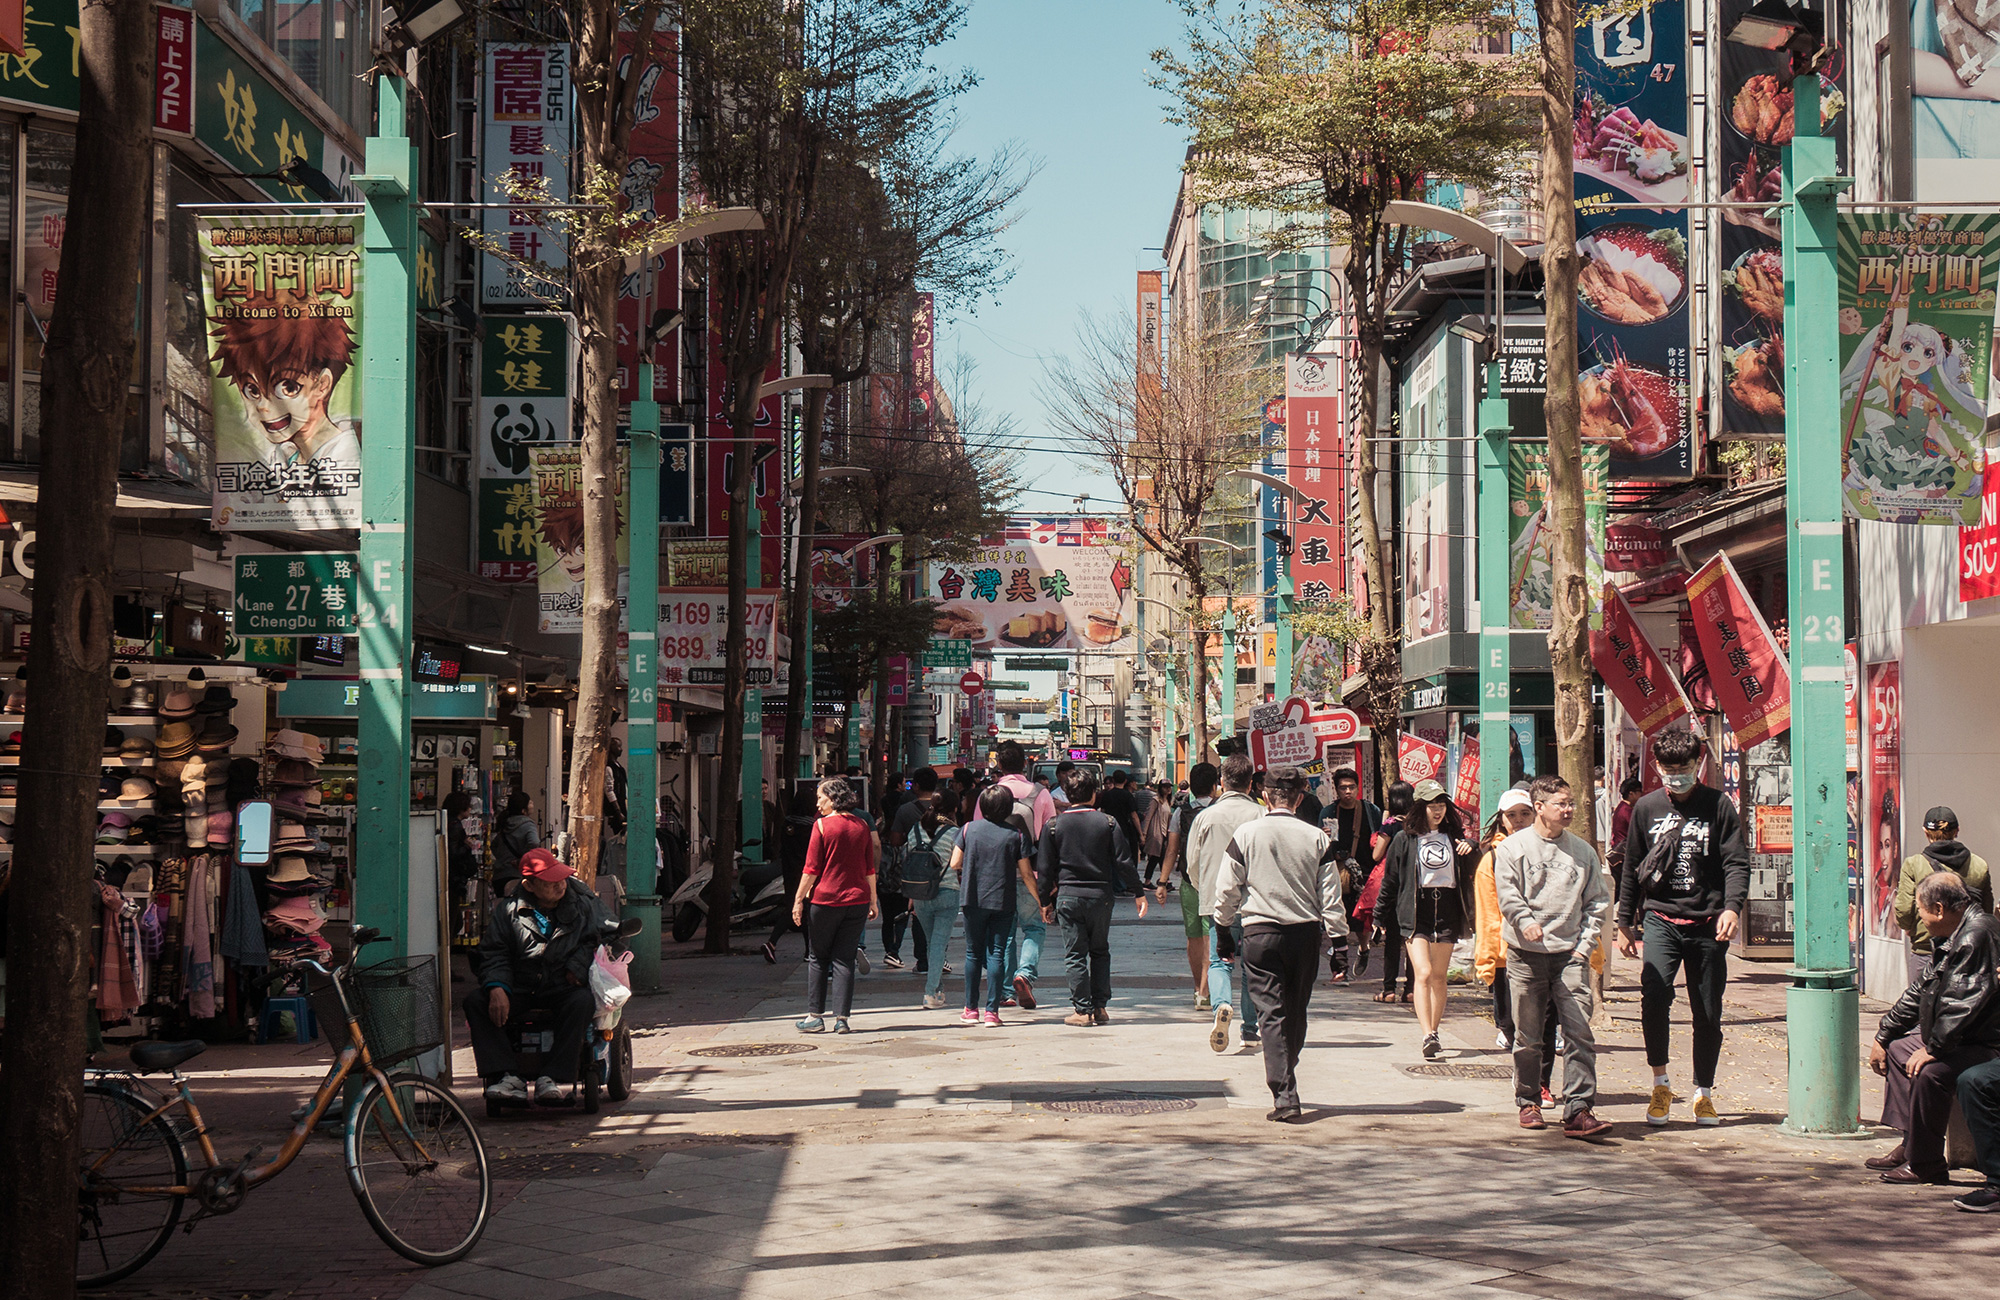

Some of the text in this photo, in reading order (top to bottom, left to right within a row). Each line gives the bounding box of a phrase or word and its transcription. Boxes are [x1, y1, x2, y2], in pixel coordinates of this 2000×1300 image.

[161, 16, 186, 124] 請上2F
[1650, 63, 1676, 83] 47
[547, 49, 565, 121] SALON
[211, 225, 355, 246] 歡迎來到優質商圈
[1861, 230, 1985, 246] 歡迎來到優質商圈
[209, 250, 360, 301] 西門町
[1857, 253, 1985, 295] 西門町
[215, 303, 354, 318] Welcome to Ximen
[1857, 298, 1978, 309] Welcome to Ximen
[1508, 346, 1544, 354] FOUNTAIN
[1515, 338, 1545, 346] HAVEN'T
[495, 323, 552, 392] 娃娃
[1304, 410, 1321, 483] 日本料理
[1299, 498, 1334, 602] 大車輪
[241, 560, 352, 579] 成都路
[373, 560, 392, 592] E
[1812, 559, 1832, 591] E
[938, 567, 1074, 602] 台灣美味
[245, 584, 347, 612] Lane 27 巷
[249, 615, 351, 630] ChengDu Rd.
[360, 602, 399, 629] 24
[673, 602, 711, 625] 169
[1803, 615, 1843, 643] 23
[663, 636, 704, 659] 689
[636, 653, 647, 673] E
[1490, 649, 1503, 667] E
[630, 686, 654, 704] 26
[746, 690, 755, 702] E
[1485, 682, 1508, 698] 25
[743, 711, 760, 724] 28
[851, 726, 857, 736] E
[848, 741, 860, 750] 32
[1304, 763, 1325, 775] ALE
[1669, 876, 1695, 884] LONDON
